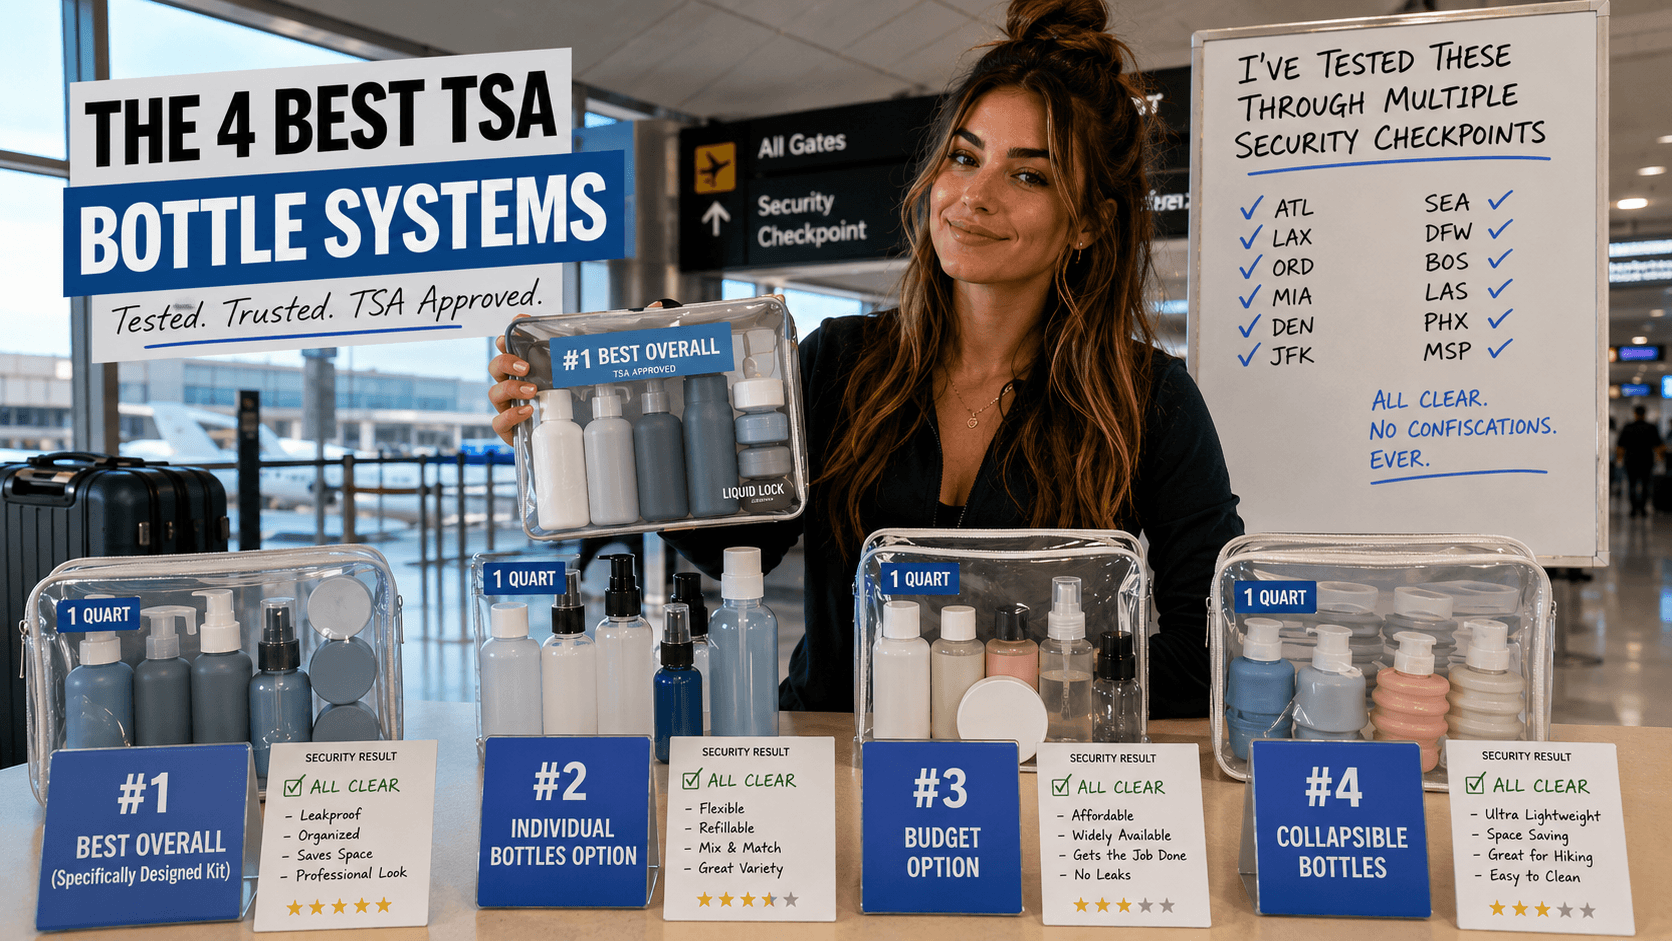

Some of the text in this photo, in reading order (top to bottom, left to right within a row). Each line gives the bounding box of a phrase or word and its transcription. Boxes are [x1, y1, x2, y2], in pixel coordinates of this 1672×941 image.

[1238, 41, 1512, 85] I'VE TESTED THESE
[1237, 82, 1518, 122] THROUGH MULTIPLE
[757, 133, 847, 159] All Gates
[1234, 120, 1546, 159] SECURITY CHECKPOINTS
[757, 191, 835, 217] Security
[1274, 198, 1315, 219] ATL
[1424, 192, 1470, 213] SEA
[757, 219, 867, 248] Checkpoint
[1272, 228, 1313, 248] LAX
[1425, 222, 1473, 243] DFW
[1272, 257, 1314, 277] ORD
[1425, 251, 1469, 273] BOS
[1272, 286, 1312, 307] MIA
[1425, 281, 1468, 302] LAS
[1272, 316, 1314, 337] DEN
[1424, 312, 1469, 333] PHX
[562, 337, 721, 371] #1 BEST OVERALL
[1269, 345, 1315, 367] JFK
[1423, 341, 1472, 362] MSP
[612, 364, 676, 378] TSA APPROVED
[1371, 388, 1488, 412] ALL CLEAR.
[1369, 416, 1557, 441] NO CONFISCATIONS.
[1370, 449, 1430, 470] EVER.
[722, 483, 785, 500] LIQUID LOCK
[493, 569, 556, 589] 1 QUART
[890, 569, 951, 588] 1 QUART
[1243, 587, 1307, 607] 1 QUART
[67, 606, 131, 626] 1 QUART
[305, 751, 398, 763] SECURITY RESULT
[702, 747, 790, 757] SECURITY RESULT
[1069, 753, 1157, 764] SECURITY RESULT
[1481, 750, 1572, 762] SECURITY RESULT
[309, 777, 401, 795] ALL CLEAR
[532, 760, 587, 801] #2
[707, 772, 797, 788] ALL CLEAR
[912, 767, 968, 809] #3
[1077, 779, 1166, 795] ALL CLEAR
[1305, 766, 1363, 808] #4
[1492, 776, 1591, 795] ALL CLEAR
[117, 771, 169, 815] #1
[300, 806, 363, 826] Leakproof
[699, 801, 745, 815] Flexible
[1071, 808, 1134, 822] Affordable
[1485, 807, 1602, 827] Ultra Lightweight
[298, 826, 361, 846] Organized
[511, 818, 615, 838] INDIVIDUAL
[699, 820, 755, 834] Refillable
[1276, 825, 1409, 849] COLLAPSIBLE
[1486, 827, 1569, 847] Space Saving
[76, 829, 227, 859] BEST OVERALL
[698, 840, 782, 854] Mix & Match
[904, 826, 982, 849] BUDGET
[1072, 828, 1172, 847] Widely Available
[297, 847, 374, 865] Saves Space
[490, 845, 637, 866] BOTTLES OPTION
[1073, 848, 1187, 862] Gets the Job Done
[1488, 847, 1594, 868] Great for Hiking
[51, 861, 231, 890] (Specifically Designed Kit)
[296, 865, 408, 882] Professional Look
[698, 861, 784, 880] Great Variety
[906, 856, 980, 878] OPTION
[1074, 867, 1132, 881] No Leaks
[1299, 855, 1387, 879] BOTTLES
[1490, 868, 1581, 888] Easy to Clean
